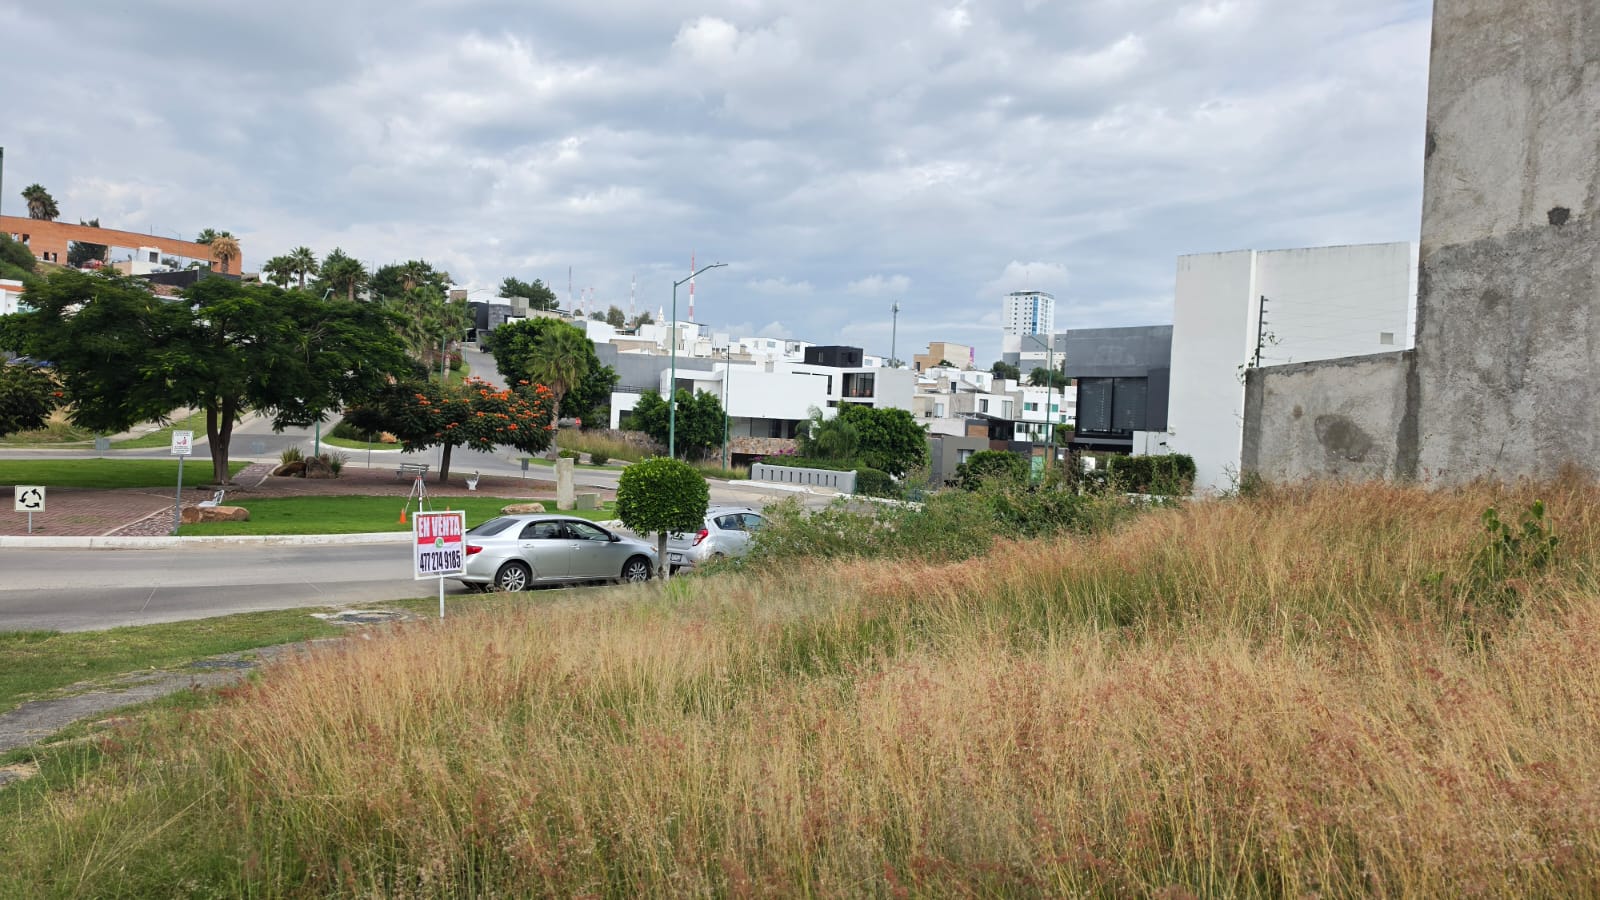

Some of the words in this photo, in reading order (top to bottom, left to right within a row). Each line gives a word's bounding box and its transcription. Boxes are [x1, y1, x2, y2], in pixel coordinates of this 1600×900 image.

[418, 516, 430, 537] EN
[431, 515, 460, 536] VENTA
[420, 552, 430, 571] 477
[431, 551, 443, 570] 274
[444, 550, 460, 569] 9185
